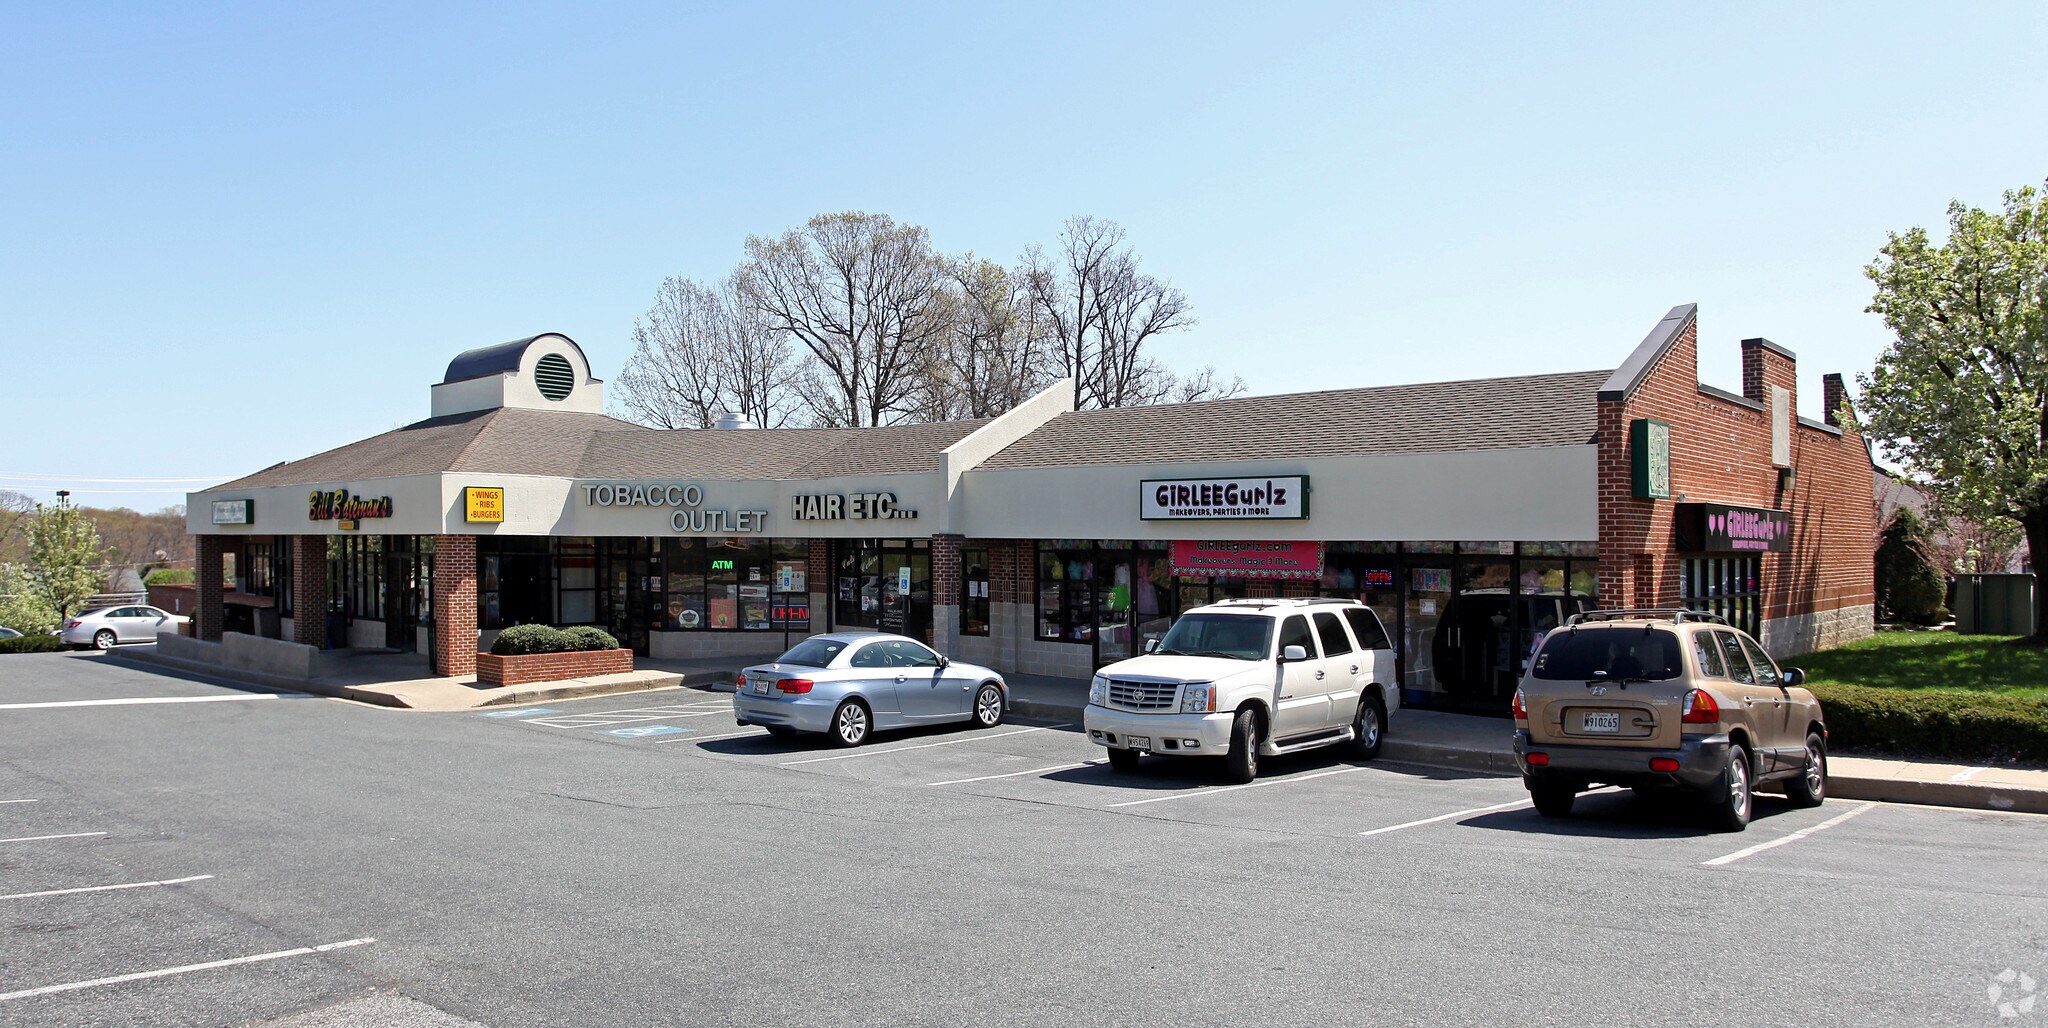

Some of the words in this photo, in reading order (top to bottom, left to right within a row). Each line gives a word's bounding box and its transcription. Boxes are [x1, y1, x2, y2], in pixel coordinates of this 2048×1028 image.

[475, 491, 499, 499] WINGS
[581, 484, 703, 507] TOBACCO
[309, 490, 333, 520] Bill
[479, 500, 495, 508] RIBS
[792, 494, 842, 520] HAIR
[849, 492, 917, 520] ETC...
[473, 510, 501, 519] BURGERS
[1169, 508, 1212, 517] MAKEOVERS,
[1212, 507, 1241, 516] PARTIES
[1248, 507, 1270, 516] MORE
[670, 509, 767, 532] OUTLET
[712, 560, 733, 570] ATM
[1367, 572, 1391, 583] OPEN
[1416, 571, 1447, 590] OPEN
